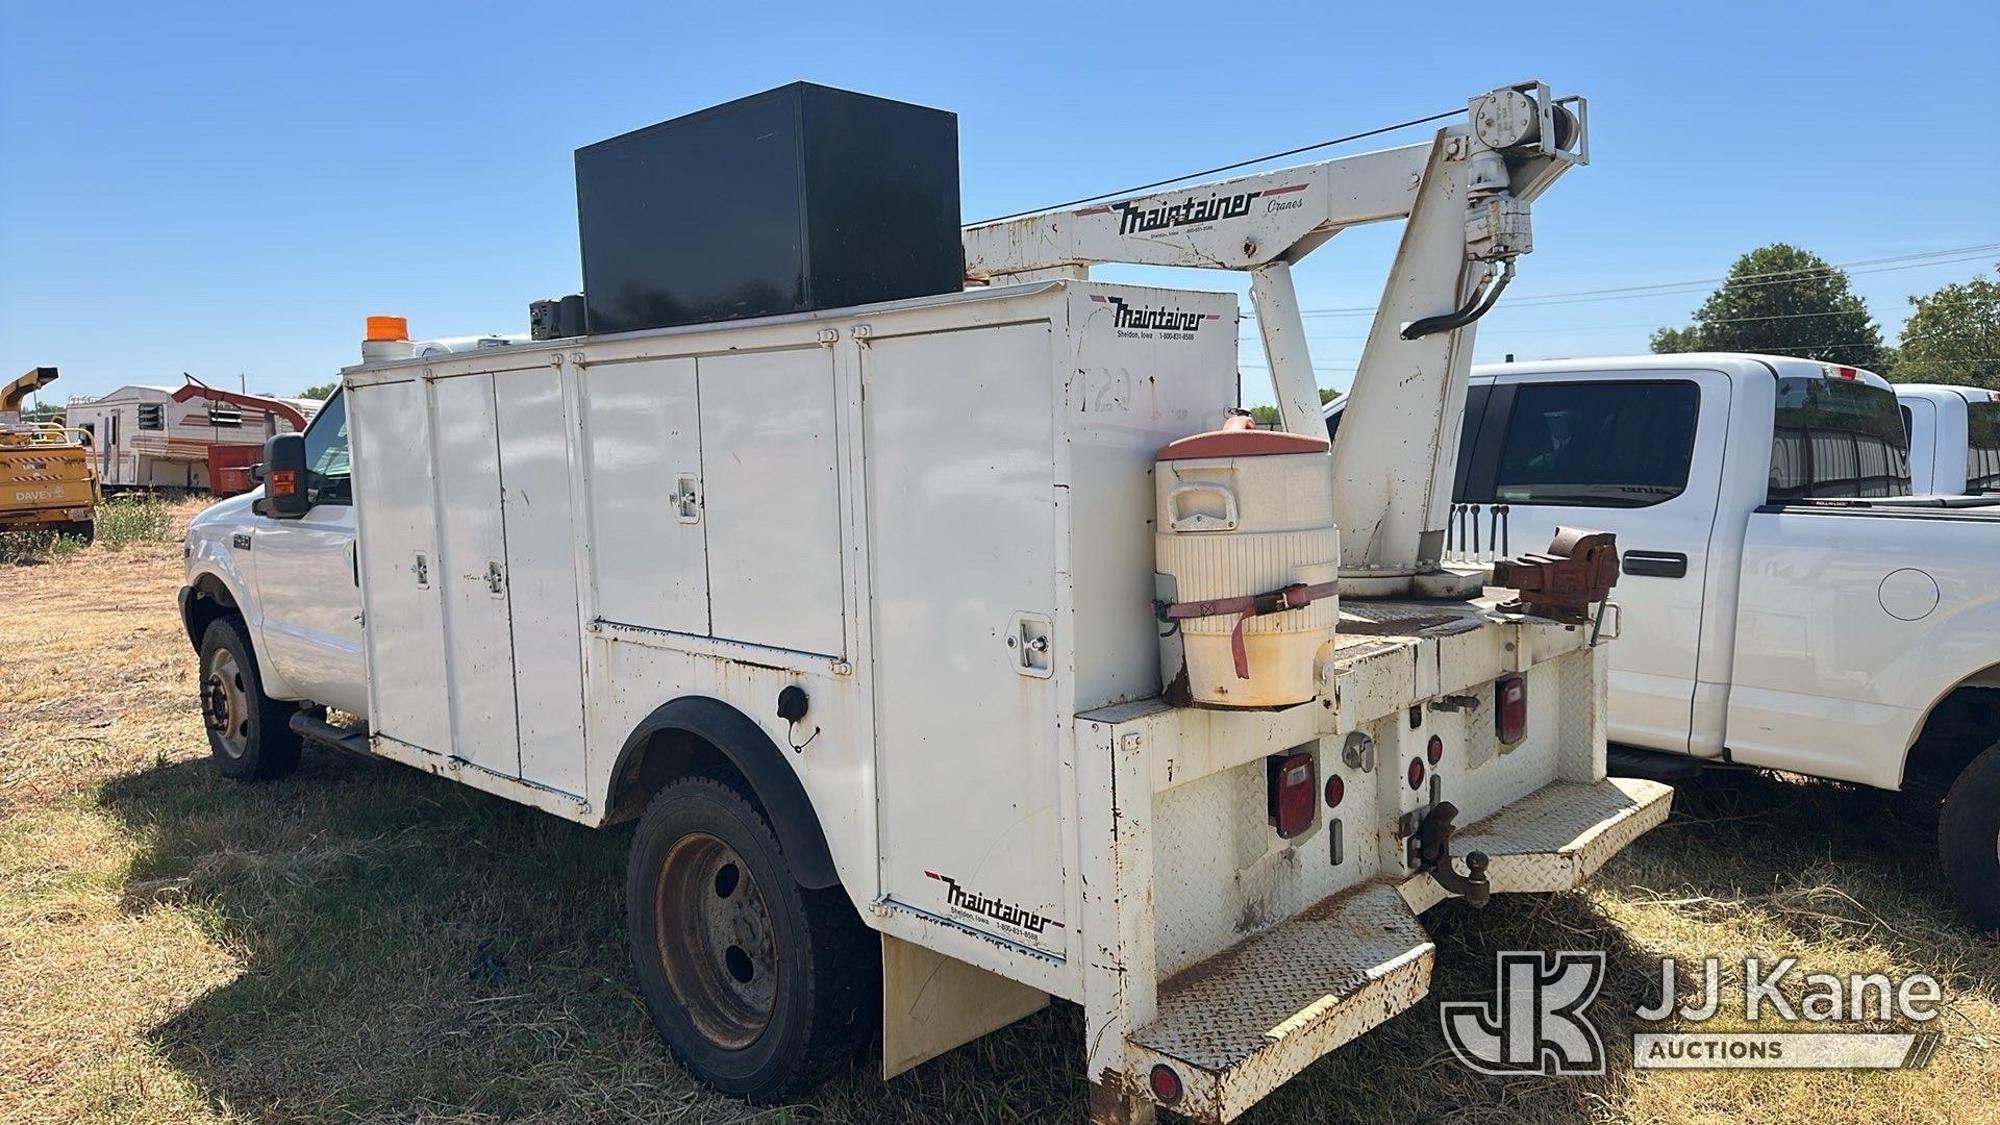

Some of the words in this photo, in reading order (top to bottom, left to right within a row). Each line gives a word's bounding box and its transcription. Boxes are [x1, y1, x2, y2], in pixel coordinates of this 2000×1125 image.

[1112, 191, 1262, 235] Maintainer
[1267, 198, 1304, 214] Cranes
[1108, 296, 1206, 331] Maintainer
[15, 490, 54, 501] DAVEY
[940, 875, 1052, 934] Maintainer
[950, 906, 975, 921] Sheldon,
